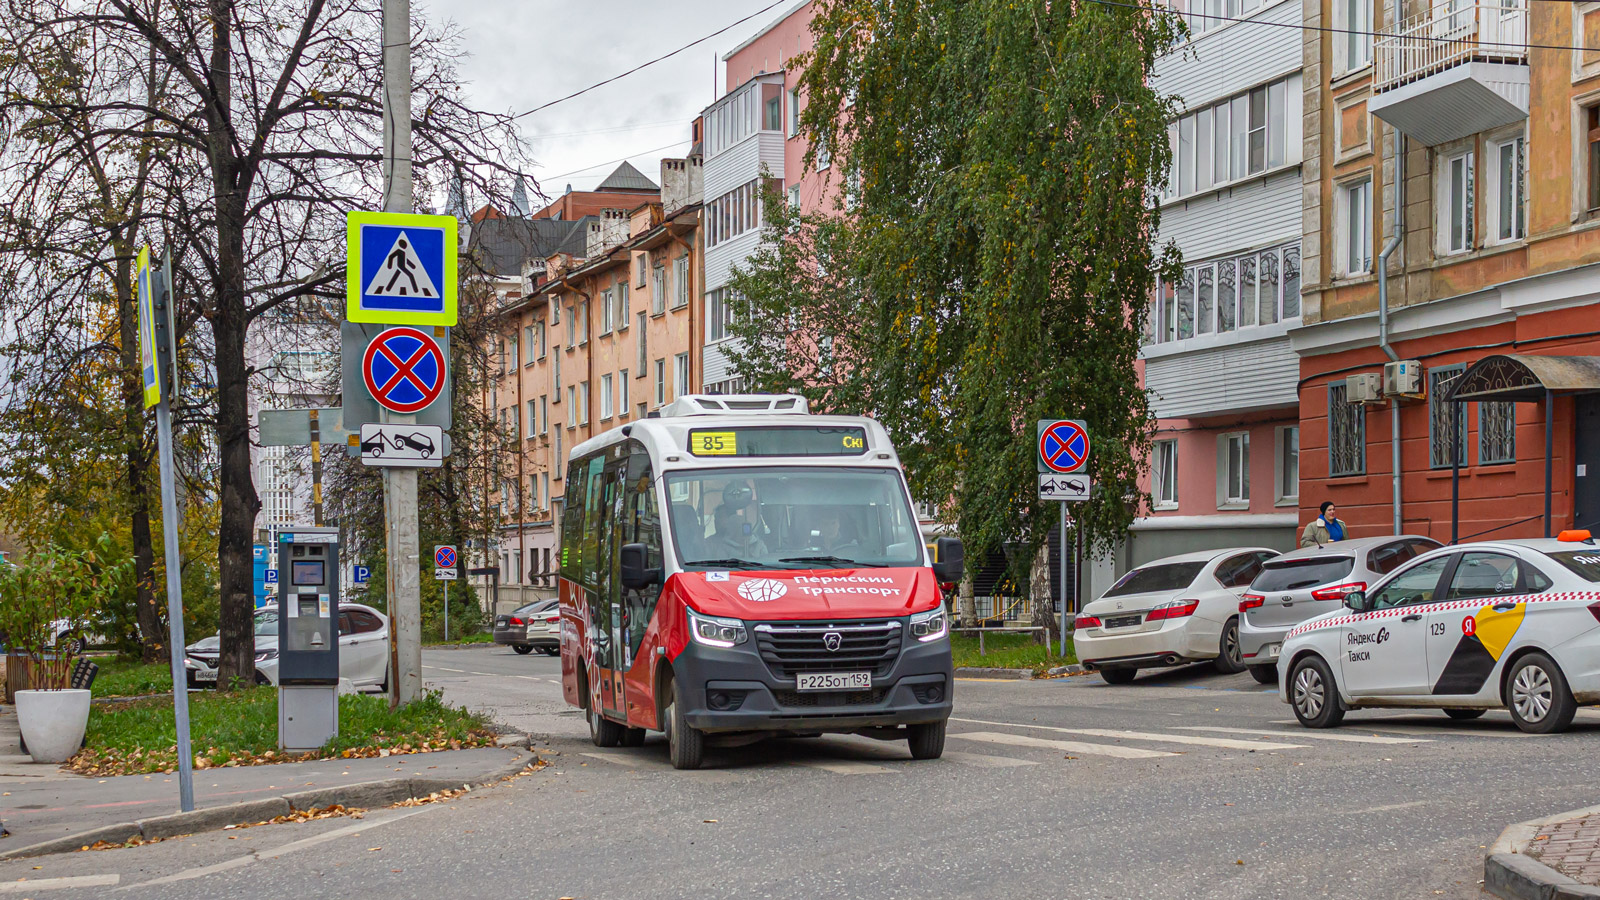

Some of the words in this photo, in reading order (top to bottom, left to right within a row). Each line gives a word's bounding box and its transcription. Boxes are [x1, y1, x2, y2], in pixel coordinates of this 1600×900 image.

[703, 436, 724, 450] 85
[798, 586, 900, 596] Транспорт
[1430, 623, 1445, 636] 129
[1465, 619, 1473, 632] Я
[1347, 632, 1376, 645] Яндекс
[1377, 627, 1390, 644] Go
[1347, 650, 1370, 662] Такси
[801, 675, 848, 689] Р225ОТ
[850, 673, 868, 684] 159
